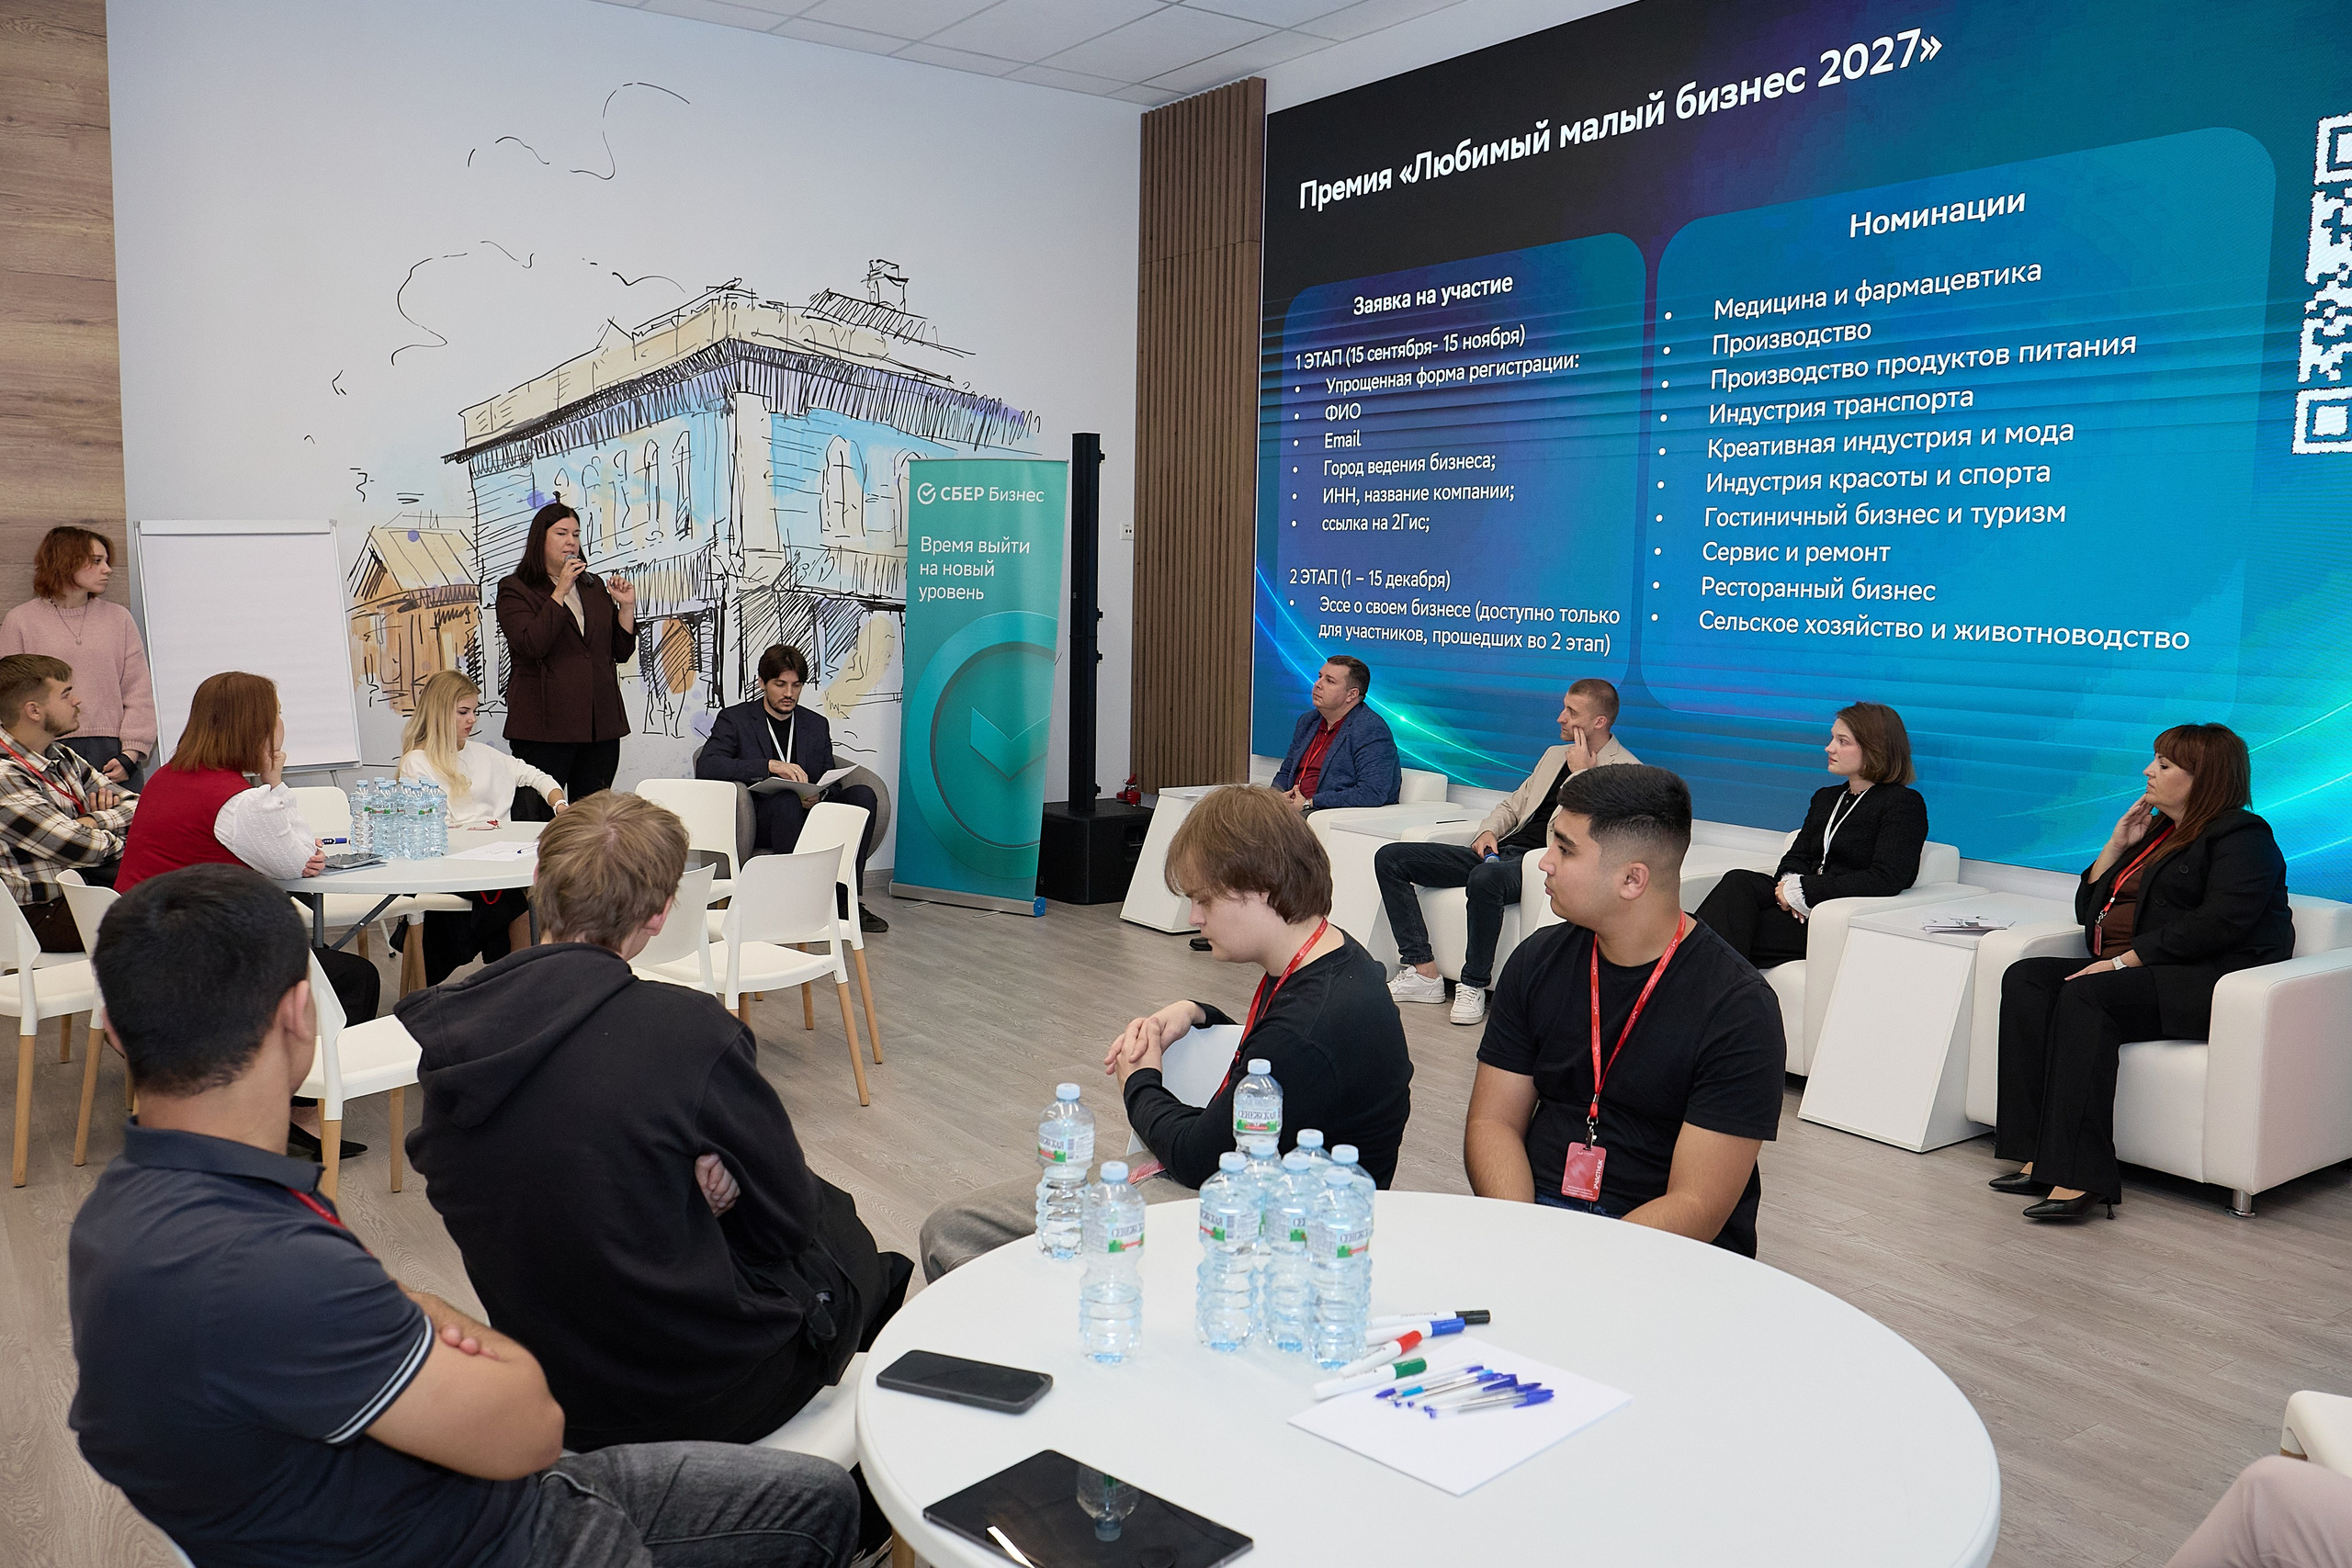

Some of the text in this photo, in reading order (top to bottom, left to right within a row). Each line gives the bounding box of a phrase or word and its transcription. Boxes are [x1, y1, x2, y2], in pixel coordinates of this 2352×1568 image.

[1300, 28, 1943, 212] Премия «Любимый малый бизнес 2027»
[1849, 193, 2026, 238] Номинации
[1353, 276, 1513, 316] Заявка на участие
[1714, 264, 2041, 321] Медицина и фармацевтика
[1295, 323, 1525, 370] 1 ЭТАП (15 сентября- 15 ноября)
[1713, 323, 1871, 358] Производство
[1326, 354, 1579, 396] Упрощенная форма регистрации:
[1711, 335, 2137, 393] Производство продуктов питания
[1325, 402, 1362, 422] ФИО
[1710, 390, 1973, 426] Индустрия транспорта
[1324, 429, 1362, 449] Email
[1708, 423, 2074, 463] Креативная индустрия и мода
[1324, 452, 1496, 479] Город ведения бизнеса;
[940, 486, 1045, 502] СБЕР Бизнес
[1323, 485, 1515, 506] ИНН, название компании;
[1706, 465, 2051, 497] Индустрия красоты и спорта
[1321, 513, 1430, 534] ссылка на 2Гис;
[1705, 502, 2066, 529] Гостиничный бизнес и туризм
[921, 536, 1030, 556] Время выйти
[1702, 541, 1892, 567] Сервис и ремонт
[920, 559, 995, 577] на новый
[1289, 568, 1297, 584] 2
[1300, 569, 1338, 585] ЭТАП
[1341, 568, 1351, 589] (1
[1368, 570, 1383, 586] 15
[1385, 569, 1451, 592] декабря)
[919, 586, 984, 603] уровень
[1702, 576, 1936, 602] Ресторанный бизнес
[1319, 595, 1621, 625] Эссе о своем бизнесе (доступно только
[1318, 624, 1611, 657] для участников, прошедших во 2 этап)
[1699, 610, 2189, 651] Сельское хозяйство и животноводство
